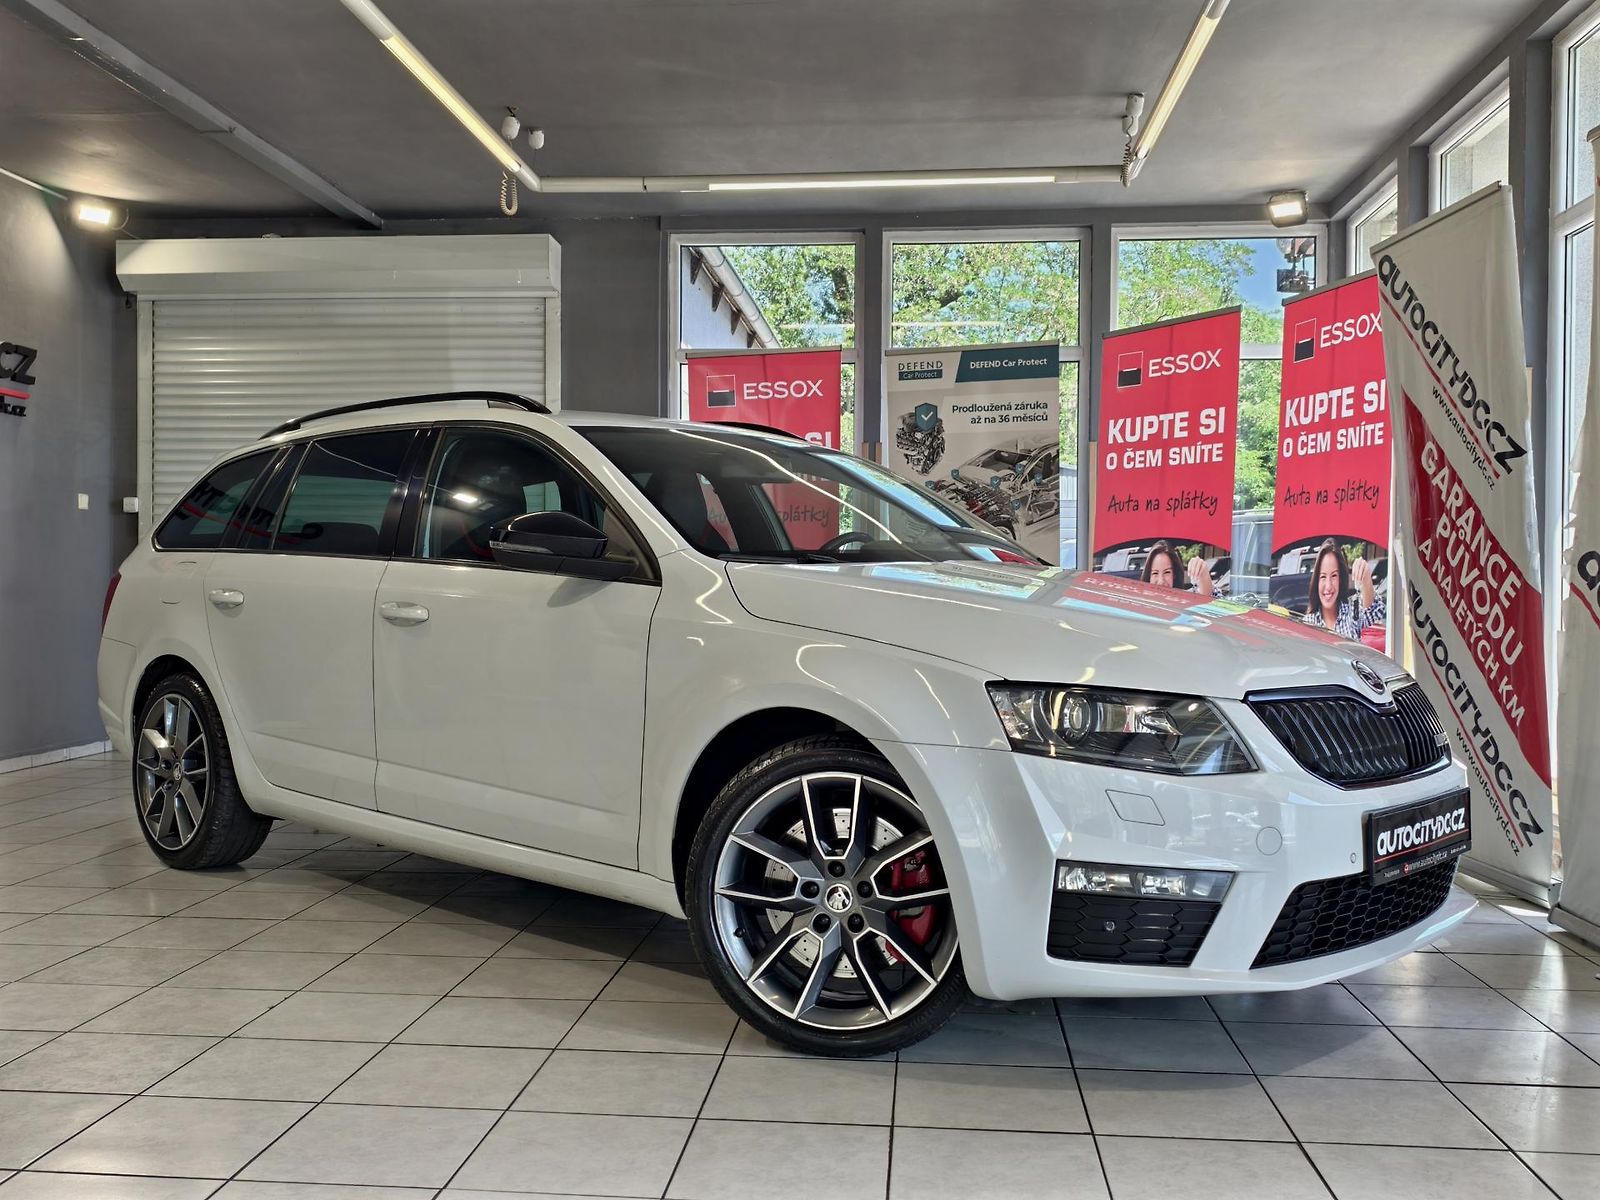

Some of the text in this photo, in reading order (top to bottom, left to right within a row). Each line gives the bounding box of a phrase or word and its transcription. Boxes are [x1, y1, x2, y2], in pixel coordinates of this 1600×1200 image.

[1320, 311, 1383, 349] ESSOX
[898, 361, 943, 371] DEFEND
[903, 371, 937, 380] Car Protect
[970, 361, 1000, 369] DEFEND
[1017, 358, 1048, 366] Protect
[1148, 348, 1222, 378] ESSOX
[743, 379, 824, 400] ESSOX
[1285, 379, 1386, 428] KUPTE SI
[952, 401, 1048, 413] Prodloužená záruka
[970, 411, 1048, 424] až na 36 měsíců
[1108, 406, 1226, 444] KUPTE SI
[1283, 421, 1384, 458] O ČEM SNÍTE
[1432, 385, 1495, 490] www.autocitydc.cz
[1106, 441, 1223, 470] O ČEM SNÍTE
[1108, 490, 1218, 517] Auta na splátky
[1283, 479, 1380, 511] Auta na splátky
[1421, 441, 1522, 609] GARANCE
[1436, 513, 1524, 665] PŮVODU
[1418, 538, 1526, 727] A NAJETÝCH KM
[1456, 727, 1520, 857] www.autocitydc.cz
